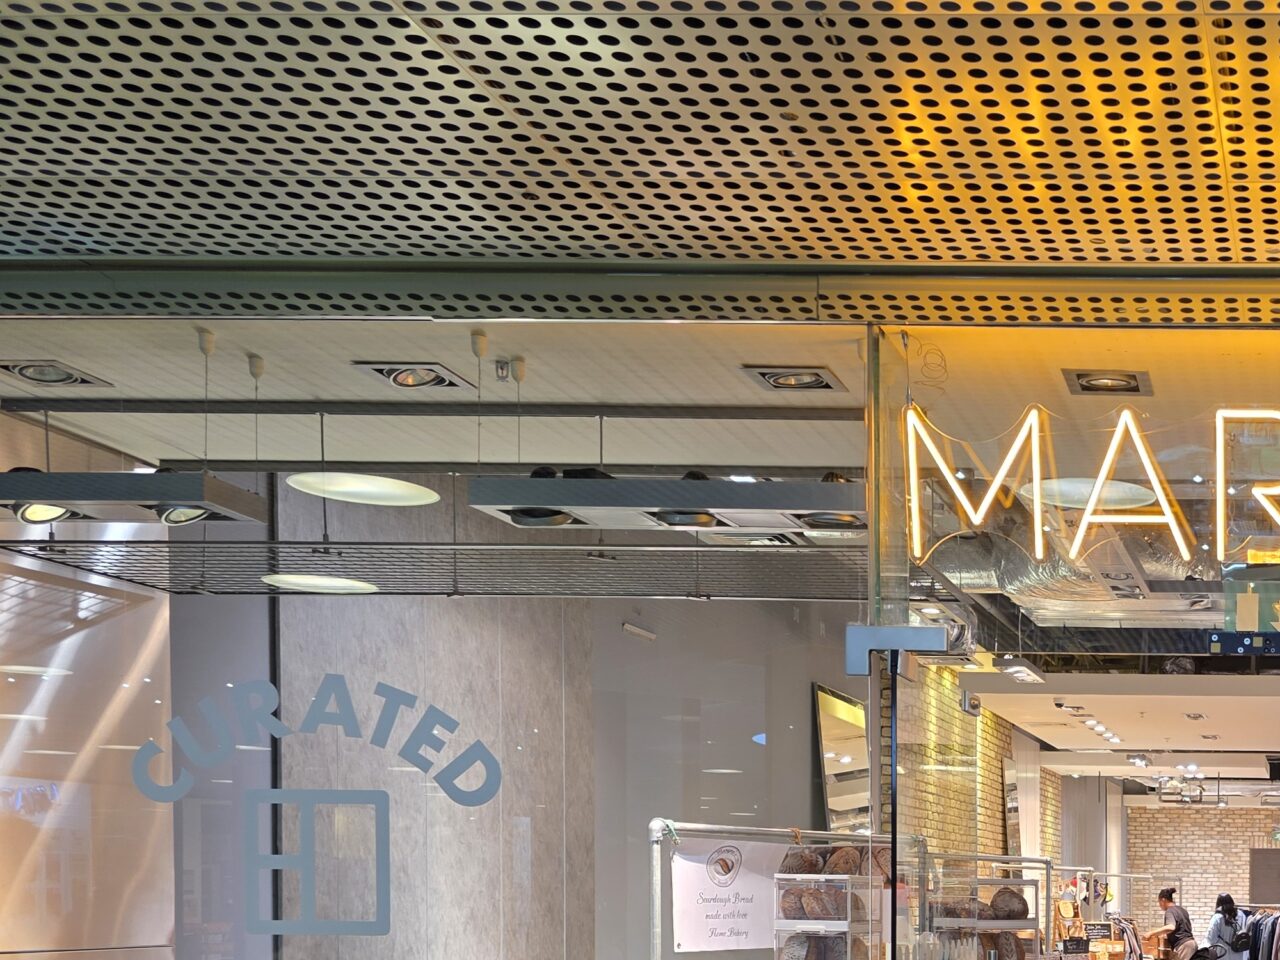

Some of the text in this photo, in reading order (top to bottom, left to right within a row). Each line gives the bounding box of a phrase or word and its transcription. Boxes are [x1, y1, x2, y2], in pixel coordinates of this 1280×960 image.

[131, 673, 502, 807] CURATED
[732, 892, 754, 904] Bread
[706, 910, 721, 919] made
[723, 910, 736, 919] with
